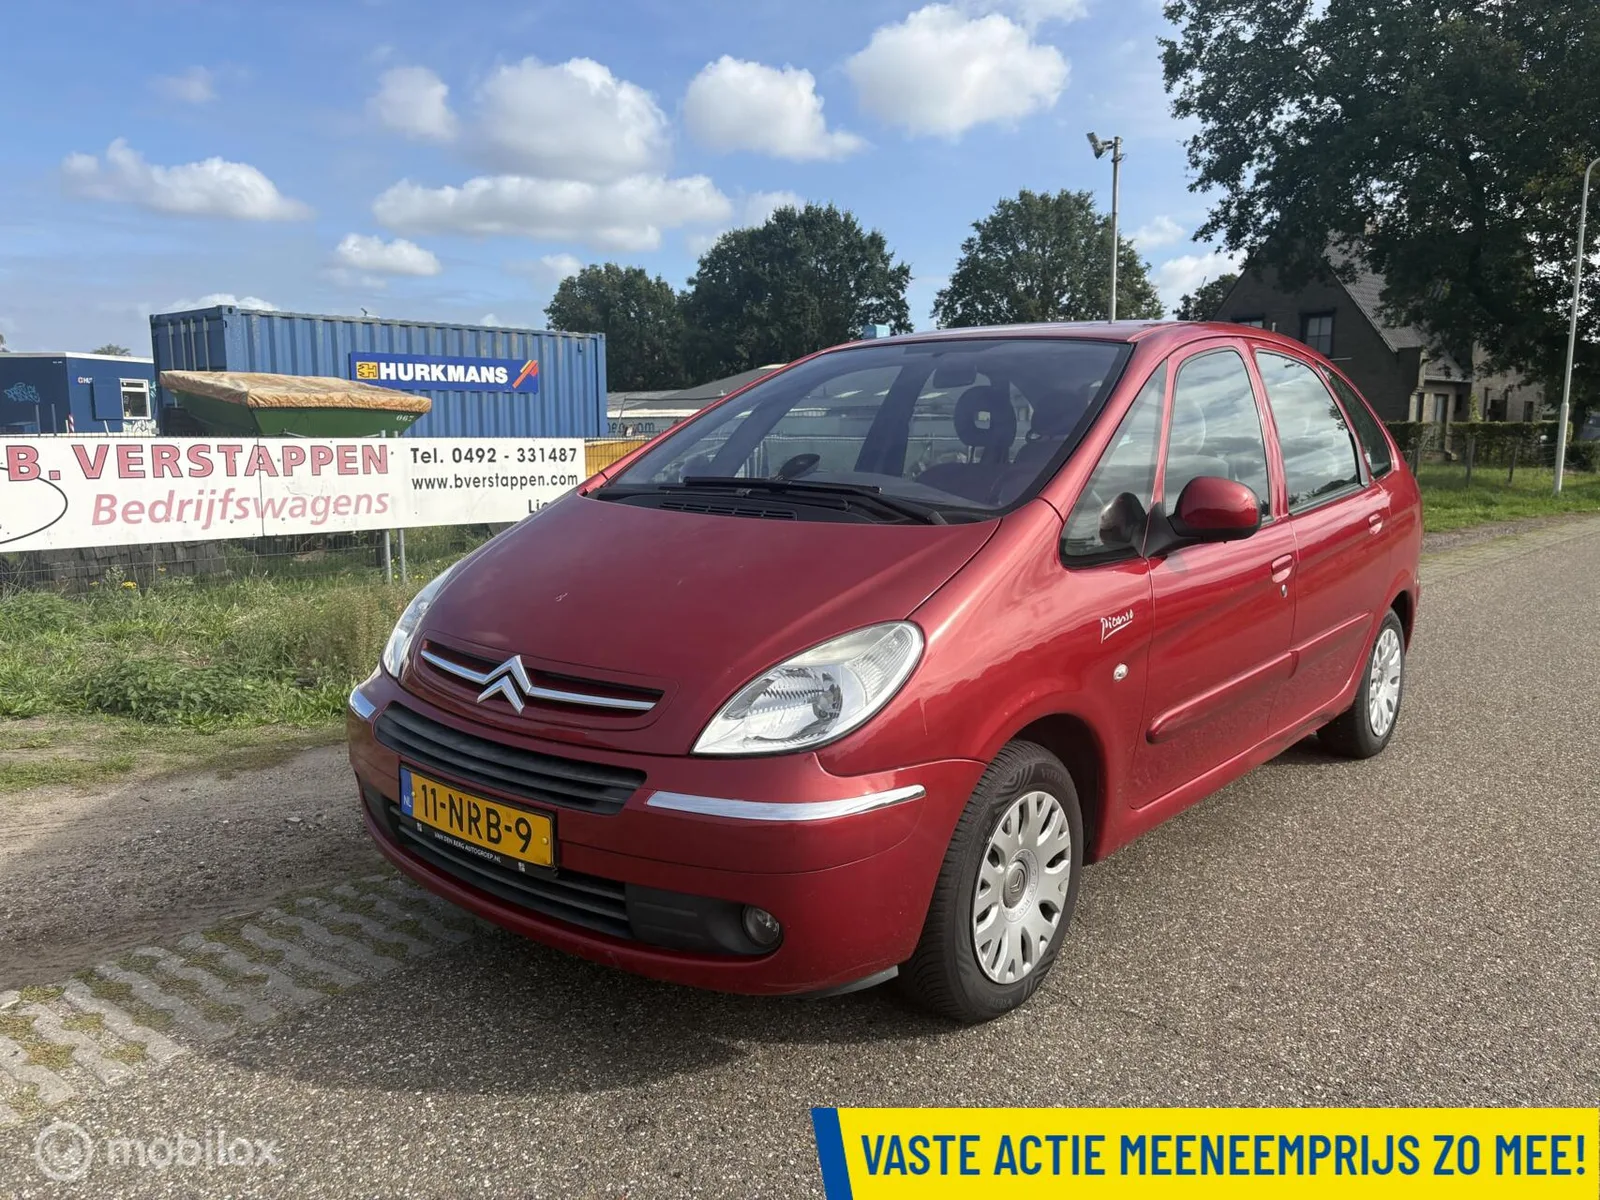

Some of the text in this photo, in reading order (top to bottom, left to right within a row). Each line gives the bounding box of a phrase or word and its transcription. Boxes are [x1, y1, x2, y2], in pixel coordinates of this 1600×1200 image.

[379, 362, 509, 384] HURKMANS
[6, 444, 389, 481] B. VERSTAPPEN
[410, 447, 444, 464] Tel.
[452, 447, 497, 464] 0492
[517, 447, 577, 463] 331487
[411, 473, 578, 490] www.bverstappen.com
[92, 488, 389, 530] Bedrijfswagens
[403, 795, 412, 808] NL
[421, 784, 532, 853] 11-NRB-9
